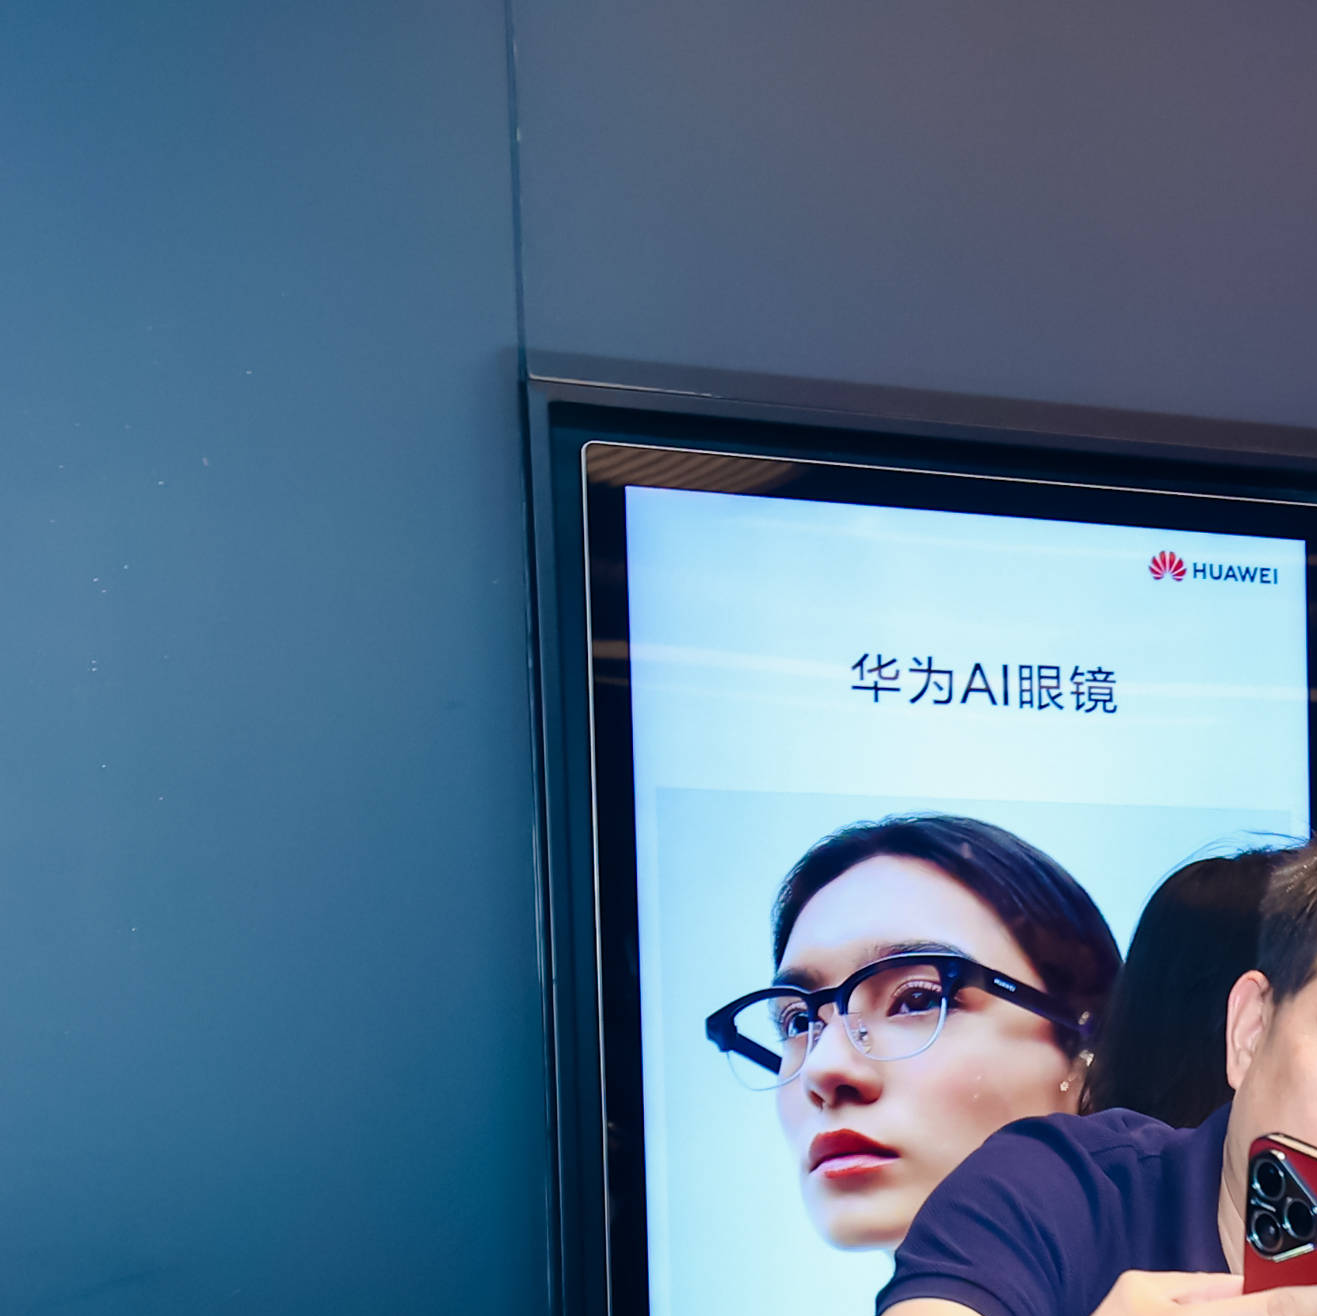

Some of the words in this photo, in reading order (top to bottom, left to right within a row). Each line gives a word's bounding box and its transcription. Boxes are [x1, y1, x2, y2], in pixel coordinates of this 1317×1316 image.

[1192, 561, 1279, 586] HUAWEI
[850, 652, 1119, 715] 华为AI眼镜
